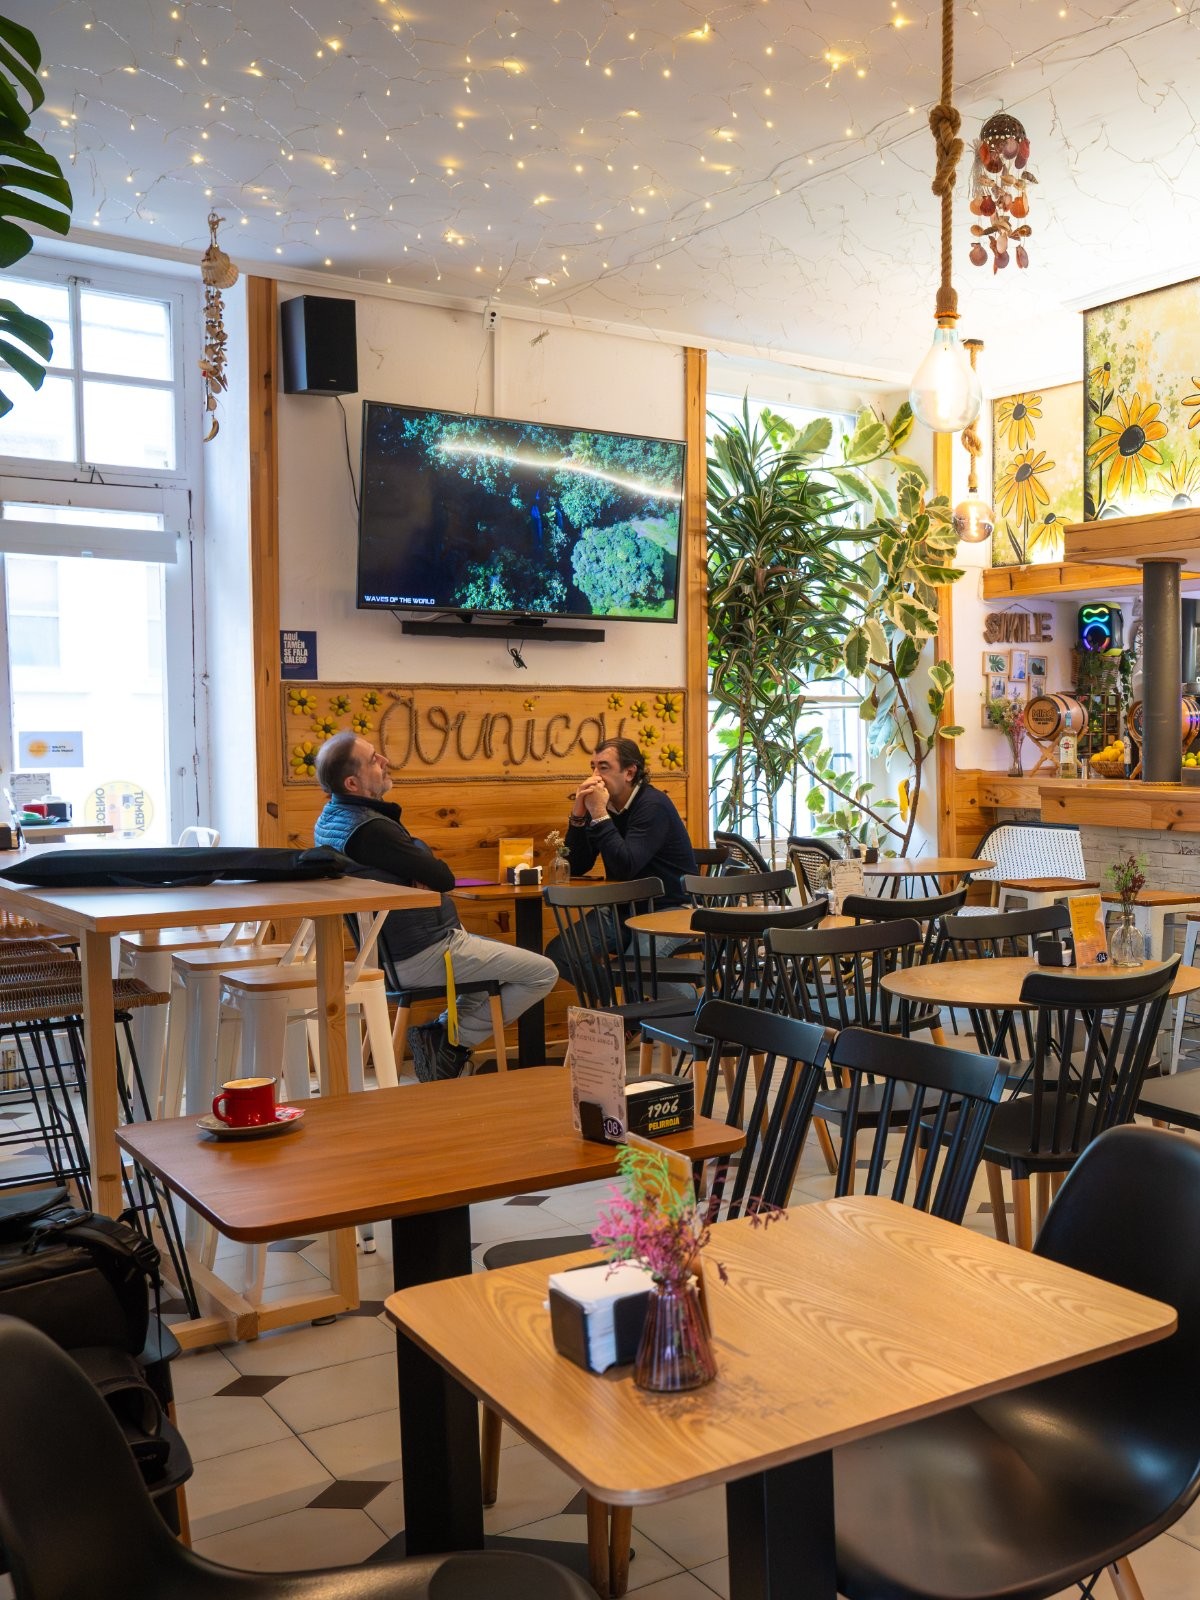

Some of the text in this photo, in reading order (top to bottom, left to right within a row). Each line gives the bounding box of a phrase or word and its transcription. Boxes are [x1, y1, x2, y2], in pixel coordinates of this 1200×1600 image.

[983, 612, 1054, 644] SMILE
[283, 632, 298, 641] AQUÍ
[283, 640, 305, 649] TAMÉN
[283, 648, 308, 657] SE FALA
[283, 656, 307, 664] GALEGO
[648, 1098, 679, 1118] 1906
[607, 1120, 619, 1136] 08
[648, 1117, 680, 1131] PELIRROJA
